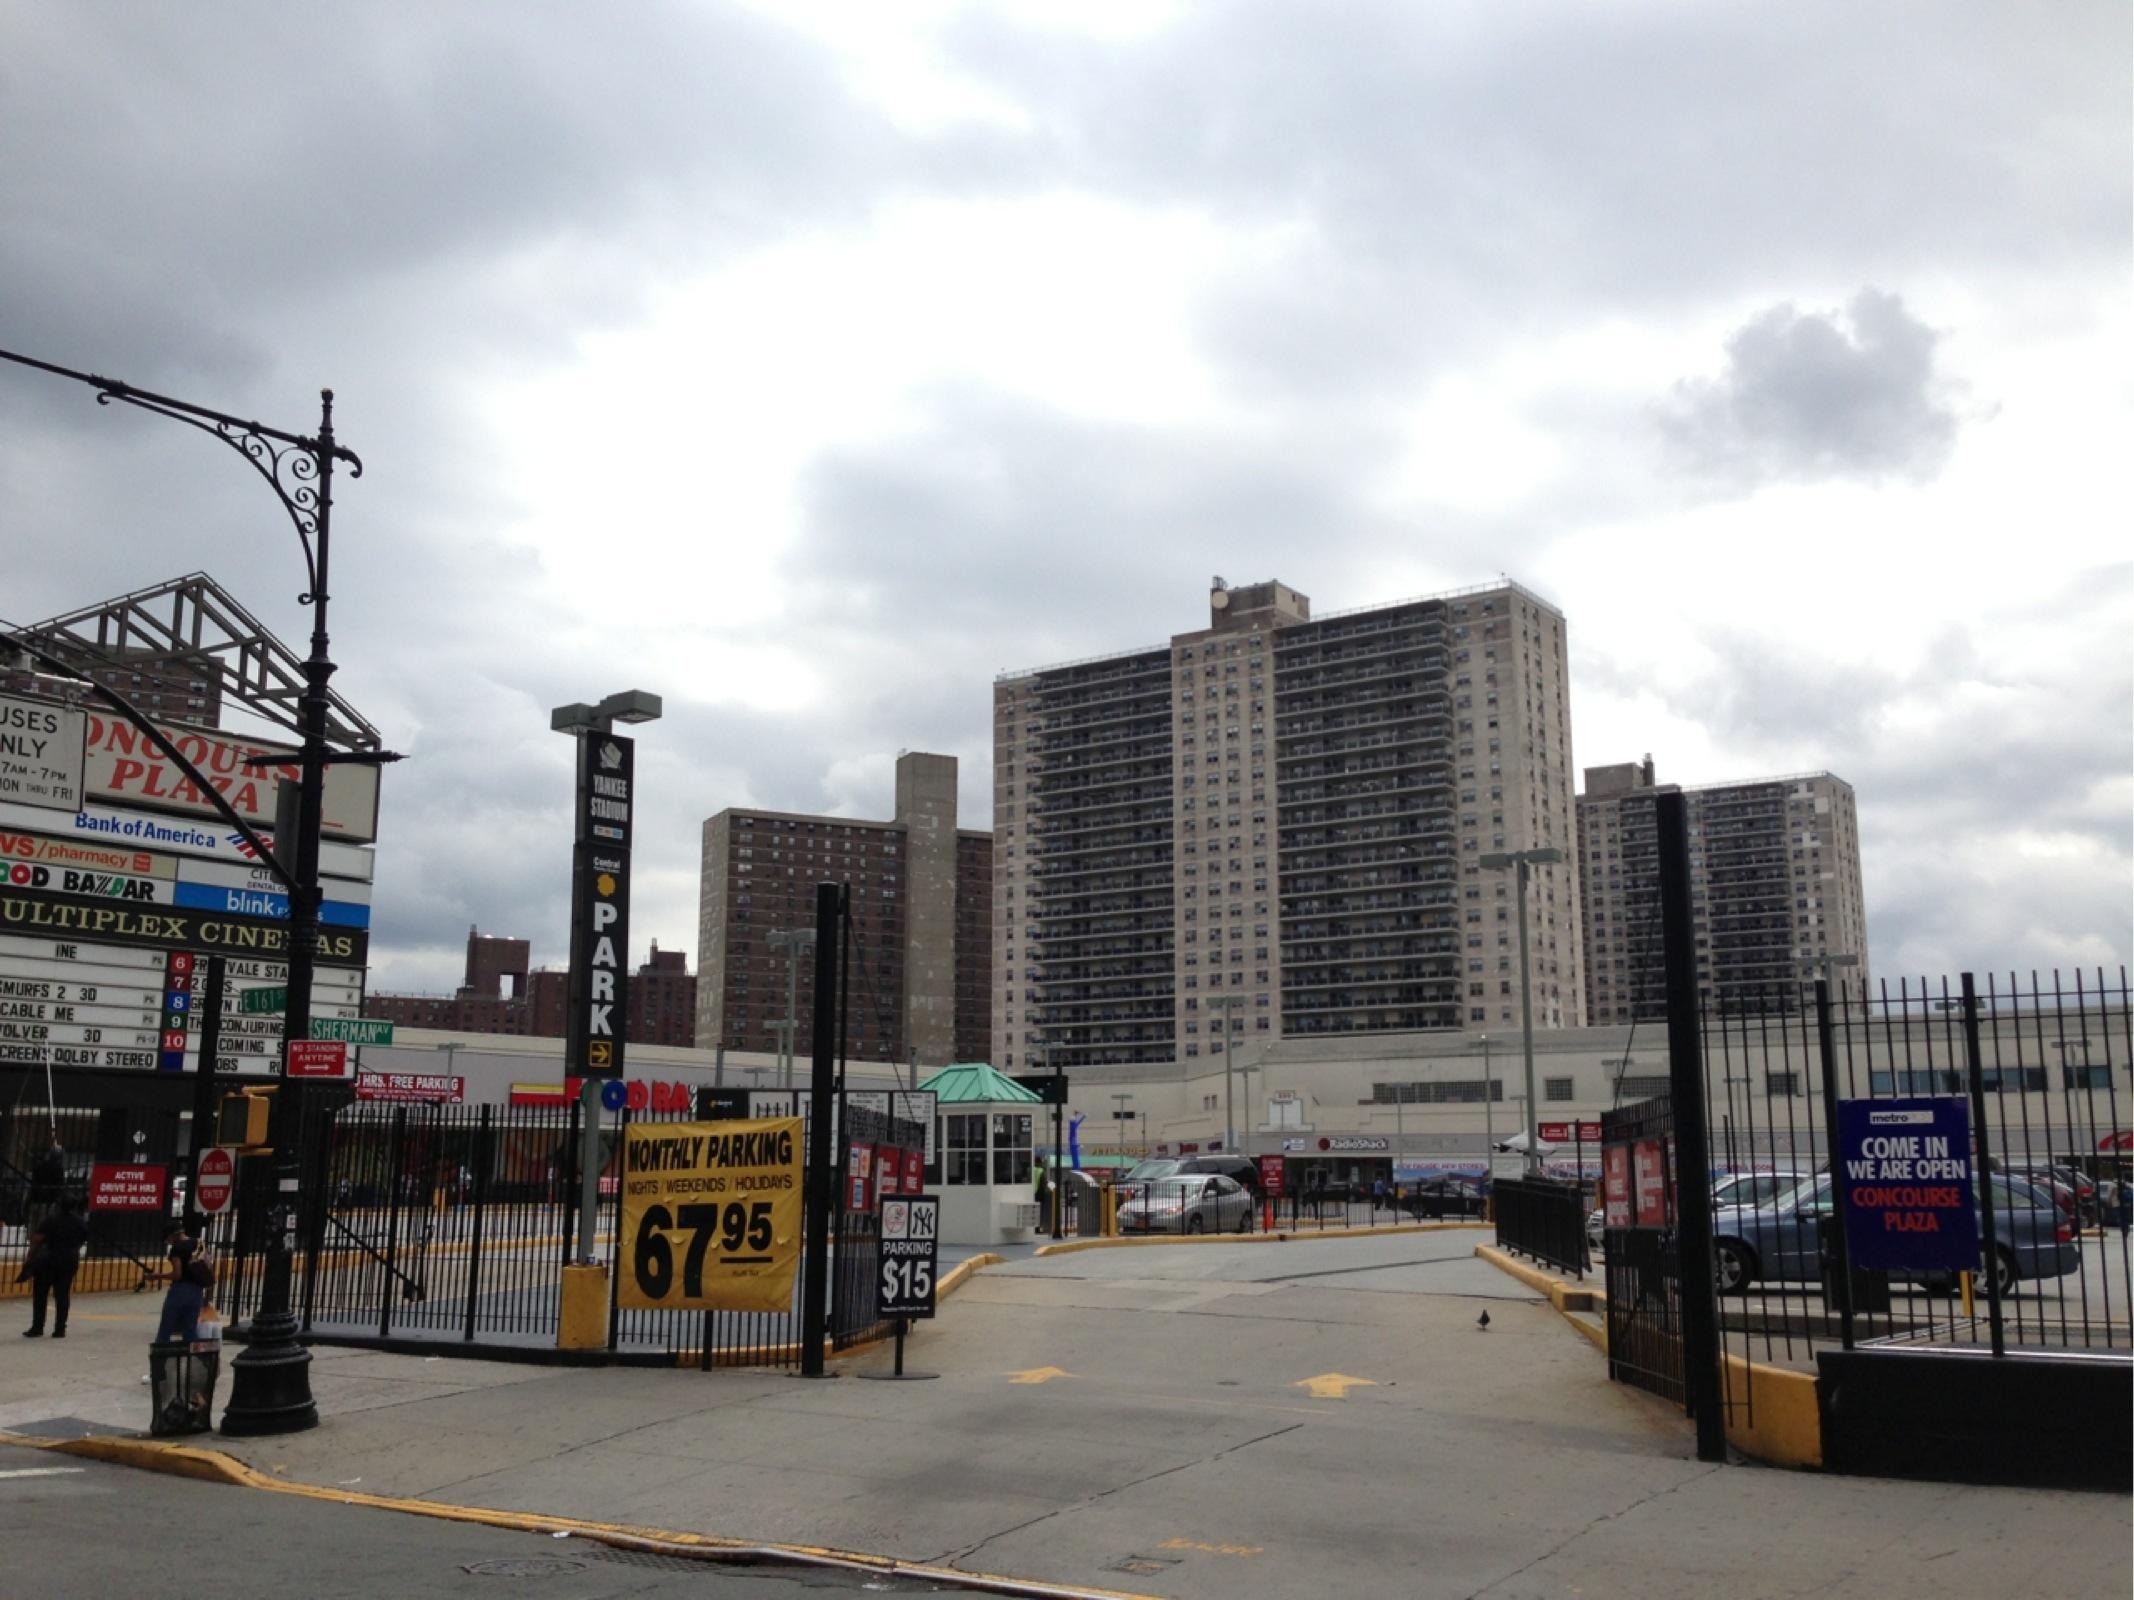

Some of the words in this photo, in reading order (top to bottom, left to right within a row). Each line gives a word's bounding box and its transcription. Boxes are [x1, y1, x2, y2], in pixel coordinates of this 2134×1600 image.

[0, 778, 19, 792] ON
[53, 787, 73, 800] FRI
[108, 758, 258, 812] PLAZA
[593, 774, 627, 798] YANKEE
[591, 796, 628, 822] STADIUM
[75, 813, 120, 834] Bank
[123, 820, 142, 836] of
[144, 822, 216, 848] America
[227, 889, 274, 915] blink
[2, 898, 188, 940] ULTIPLEX
[200, 921, 353, 957] CINEAS
[176, 956, 186, 969] 6
[590, 900, 618, 1036] PARK
[173, 976, 185, 988] 7
[57, 985, 66, 999] 2
[80, 987, 98, 1001] 3D
[254, 989, 275, 1010] 161
[173, 997, 184, 1009] 8
[55, 1007, 74, 1021] ME
[171, 1016, 182, 1029] 9
[83, 1029, 101, 1043] 3D
[313, 1020, 377, 1042] SHERMAN
[164, 1036, 184, 1048] 10
[218, 1037, 264, 1053] COMING
[307, 1044, 343, 1052] STANDING
[55, 1047, 99, 1064] DOLBY
[106, 1051, 154, 1067] STEREO
[297, 1054, 337, 1063] ANYTIME
[389, 1076, 413, 1089] FREE
[1872, 1113, 1909, 1123] metro
[628, 1136, 704, 1173] MONTHLY
[706, 1130, 793, 1168] PARKING
[1329, 1137, 1389, 1150] RadioShack
[1861, 1136, 1920, 1159] COME
[1925, 1136, 1948, 1159] IN
[203, 1162, 213, 1171] DO
[216, 1161, 229, 1171] NOT
[1847, 1159, 1876, 1180] WE
[1879, 1160, 1912, 1180] ARE
[1916, 1160, 1966, 1180] OPEN
[114, 1171, 145, 1181] ACTIVE
[628, 1179, 659, 1196] NIGHTS
[666, 1177, 726, 1193] WEEKENDS
[736, 1174, 793, 1191] HOLIDAYS
[99, 1184, 126, 1193] DRIVE
[127, 1184, 138, 1193] 24
[139, 1185, 156, 1193] HRS
[203, 1189, 224, 1199] ENTER
[1852, 1187, 1960, 1207] CONCOURSE
[96, 1195, 108, 1204] DO
[111, 1196, 128, 1205] NOT
[129, 1196, 158, 1205] BLOCK
[1884, 1211, 1940, 1232] PLAZA
[635, 1203, 718, 1300] 67
[882, 1241, 933, 1255] PARKING
[882, 1257, 931, 1304] $15
